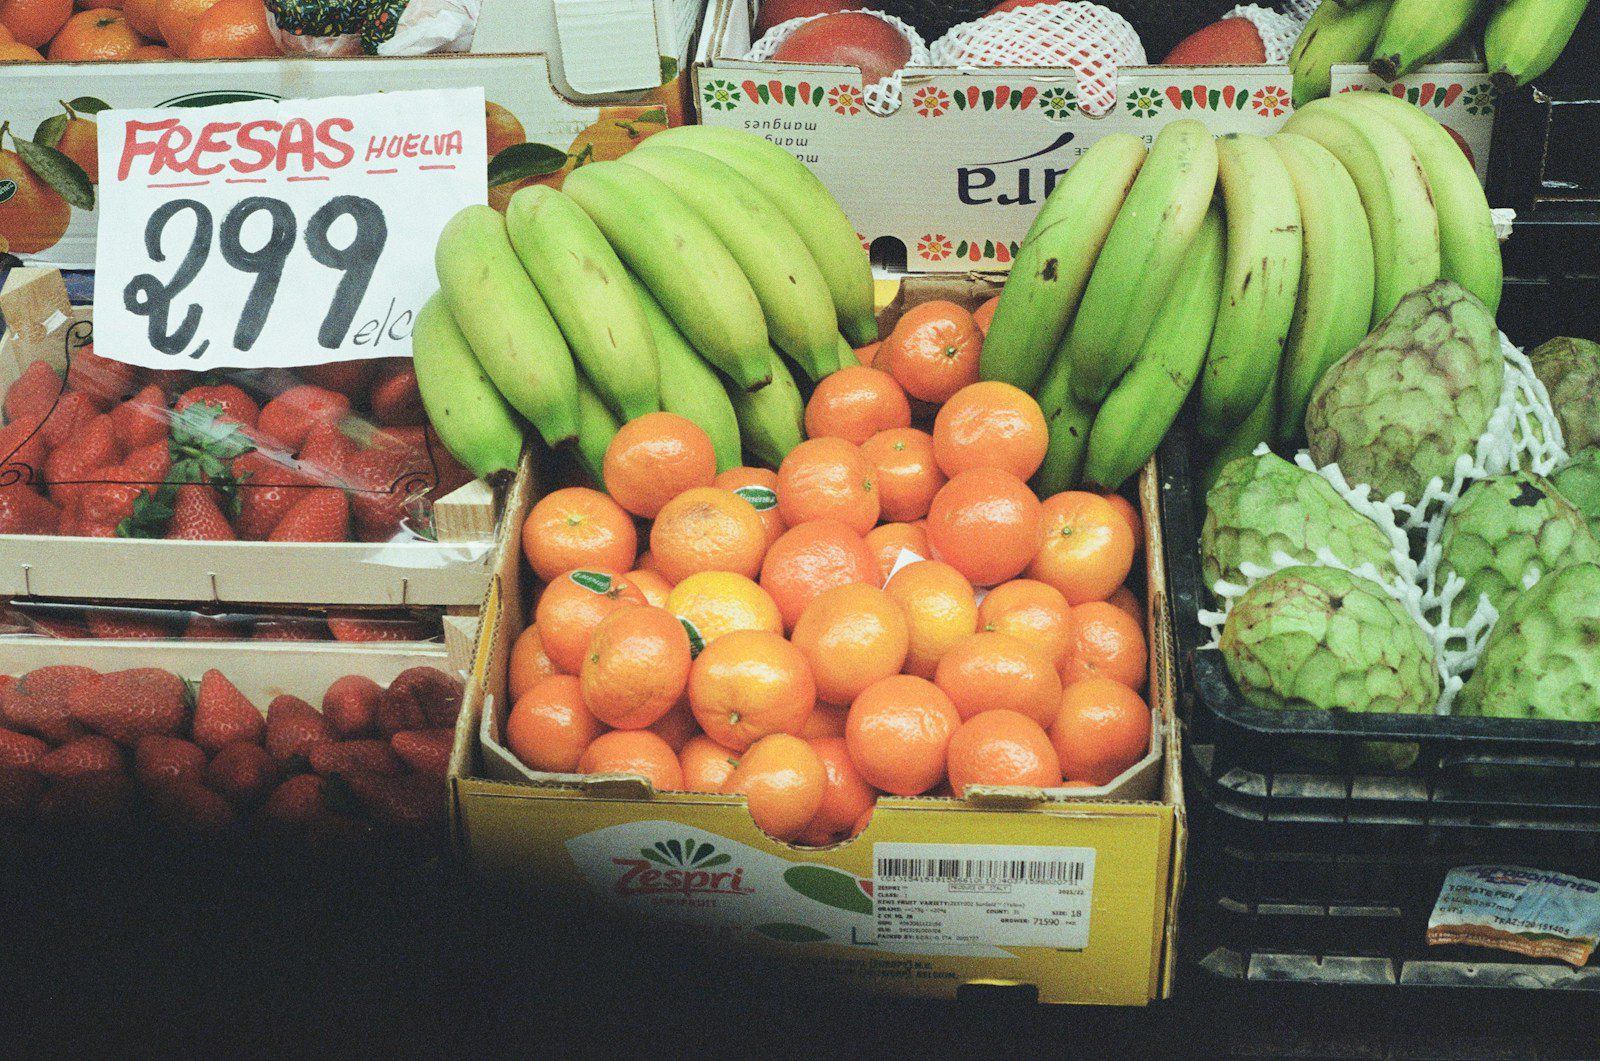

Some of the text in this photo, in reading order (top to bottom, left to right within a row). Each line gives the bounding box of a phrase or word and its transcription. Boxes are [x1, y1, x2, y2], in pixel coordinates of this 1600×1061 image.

[118, 117, 463, 181] FRESAS HUELVA
[744, 118, 818, 131] mangues
[123, 195, 388, 359] 2,99
[612, 857, 746, 896] Zespri
